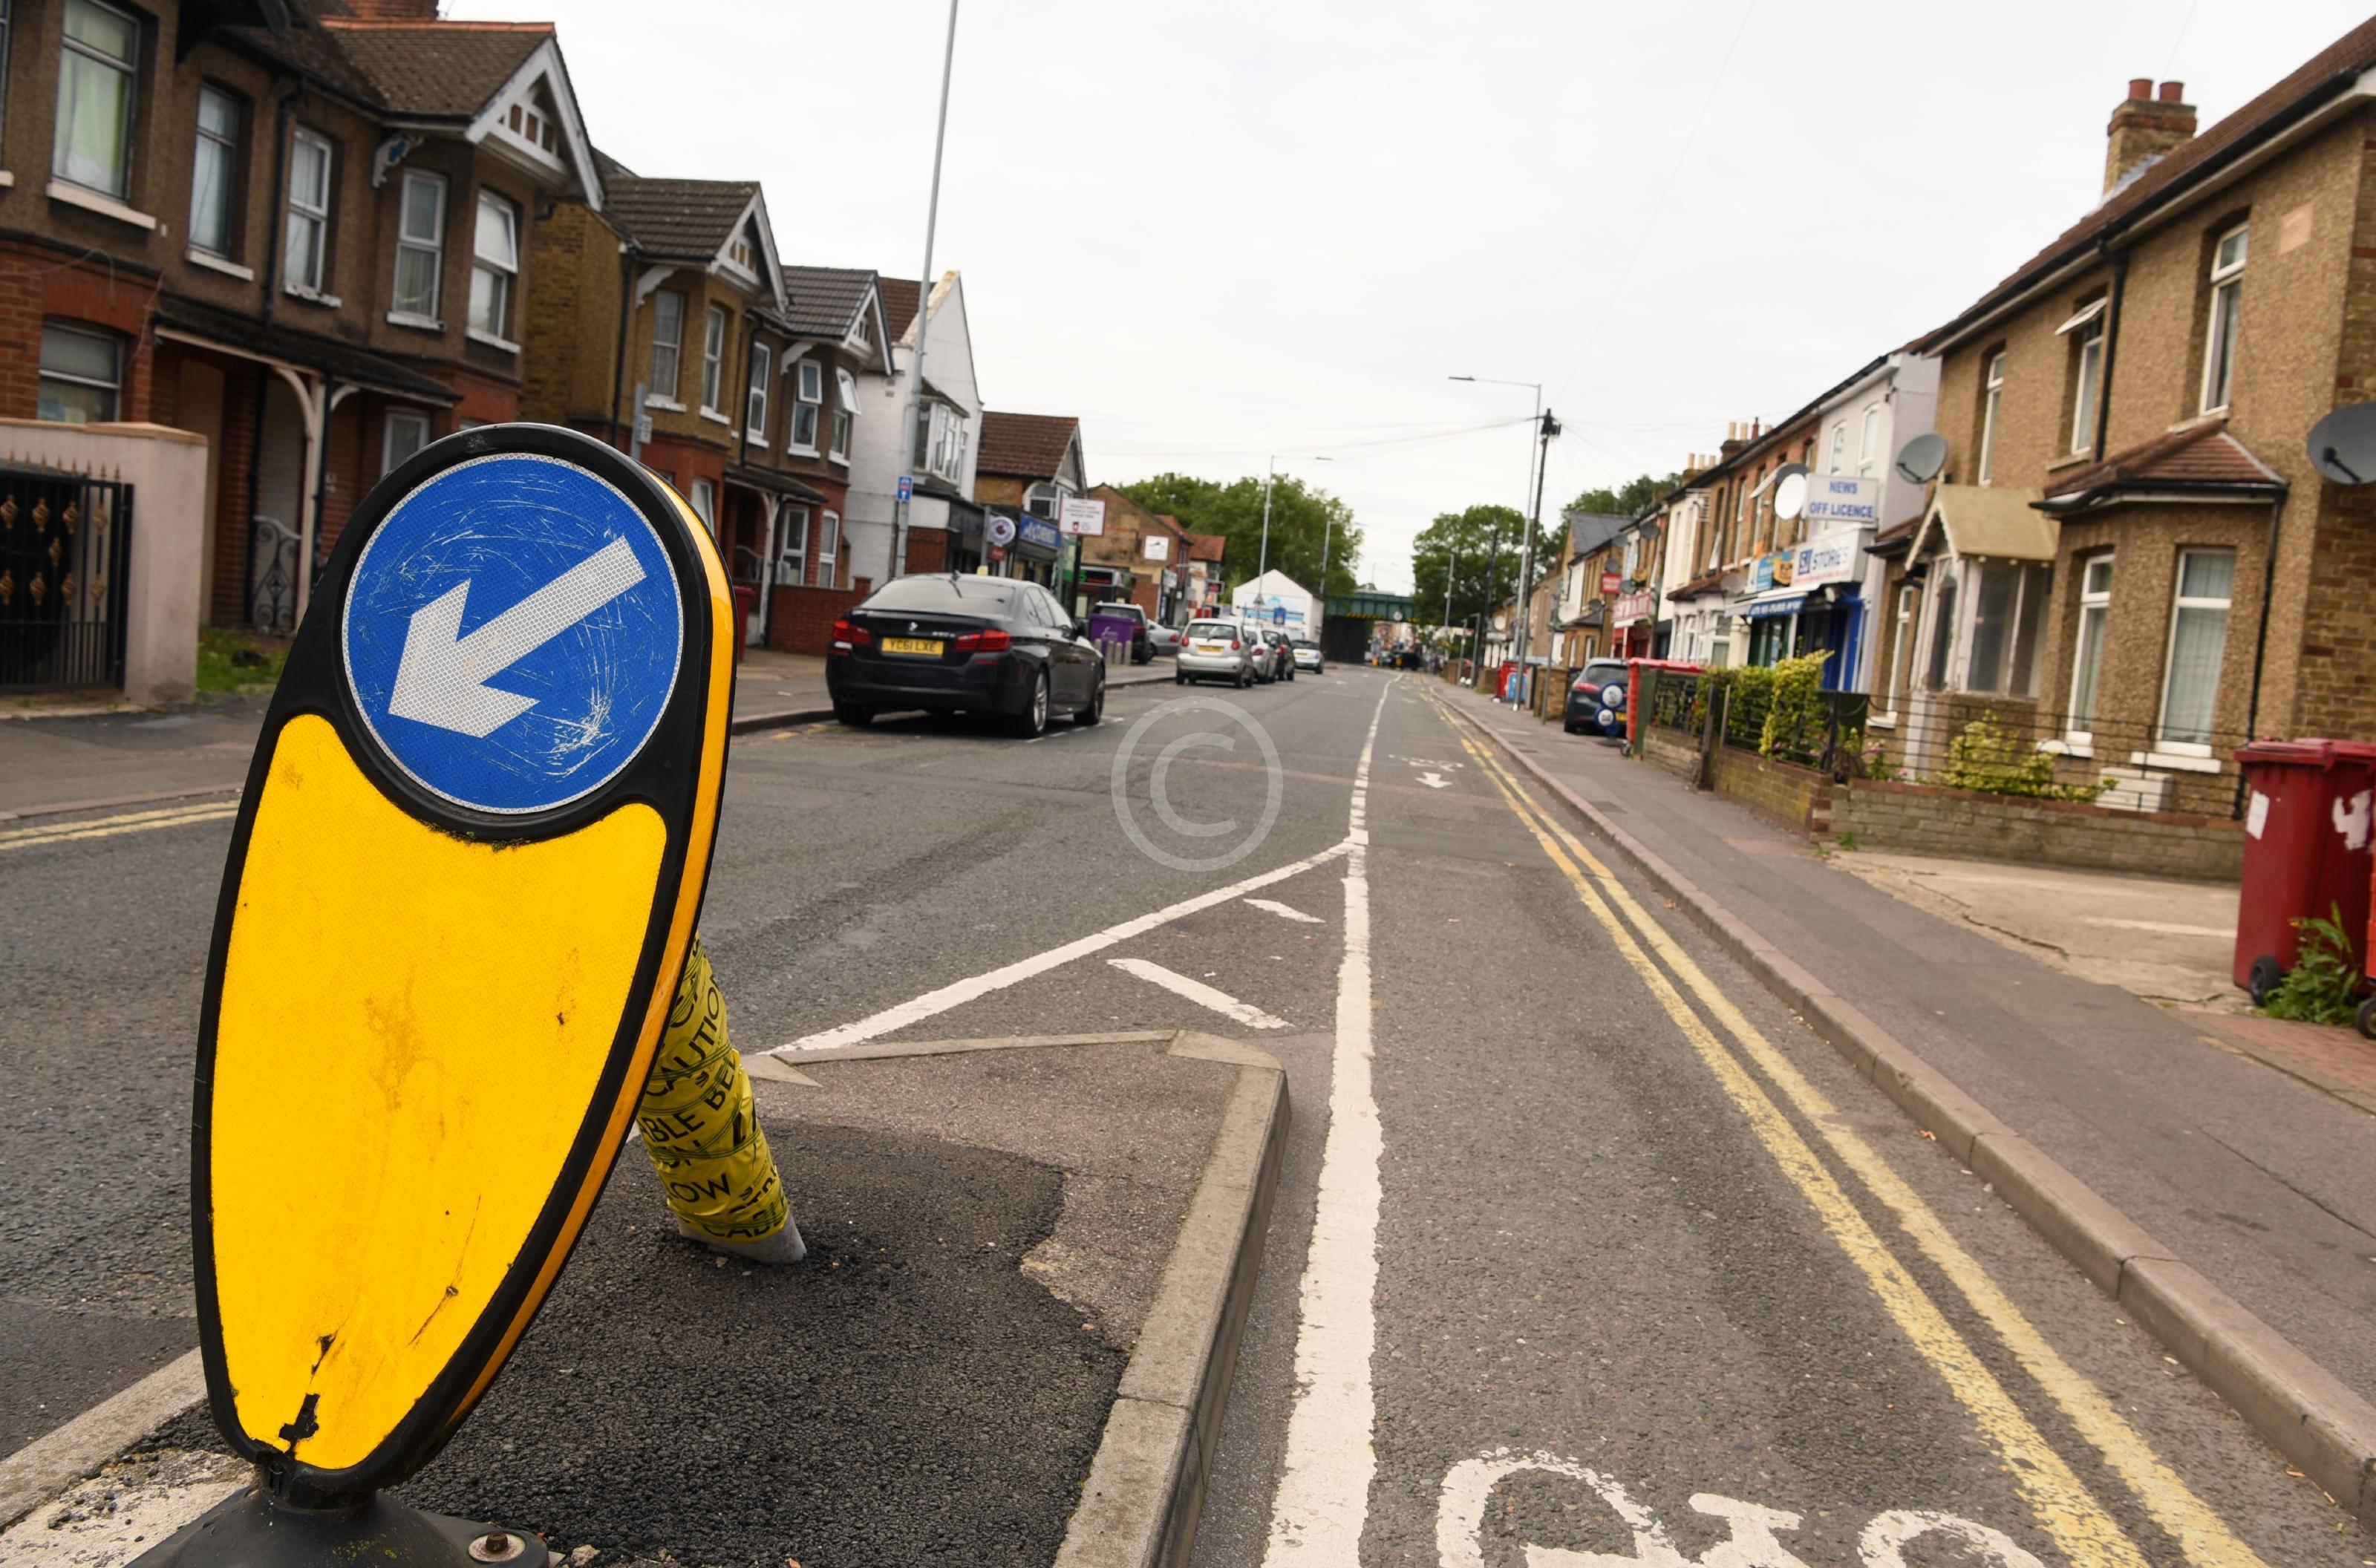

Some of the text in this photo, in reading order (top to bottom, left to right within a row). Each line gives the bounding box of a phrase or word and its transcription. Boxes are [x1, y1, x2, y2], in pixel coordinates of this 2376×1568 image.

[1829, 481, 1858, 494] NEWS
[1809, 501, 1874, 518] OFF LICENCE
[639, 1112, 705, 1143] ABLE
